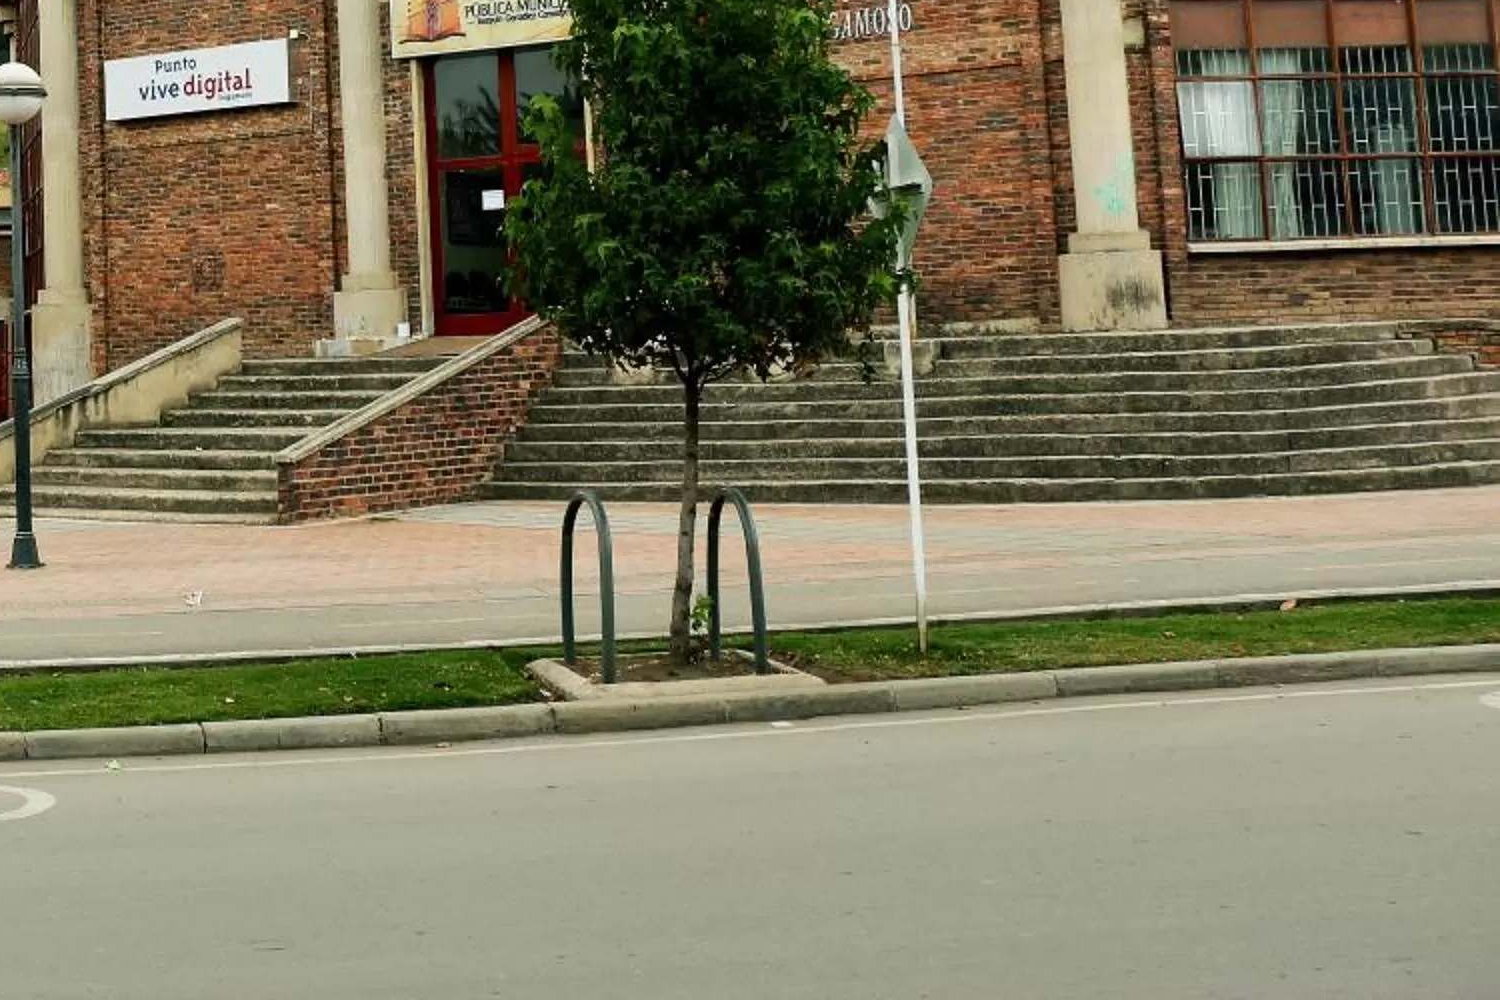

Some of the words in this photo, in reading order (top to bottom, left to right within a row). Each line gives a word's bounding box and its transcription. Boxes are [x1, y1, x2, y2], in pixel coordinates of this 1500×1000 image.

[155, 56, 197, 74] Punto
[138, 79, 180, 101] vive
[183, 67, 253, 100] digital
